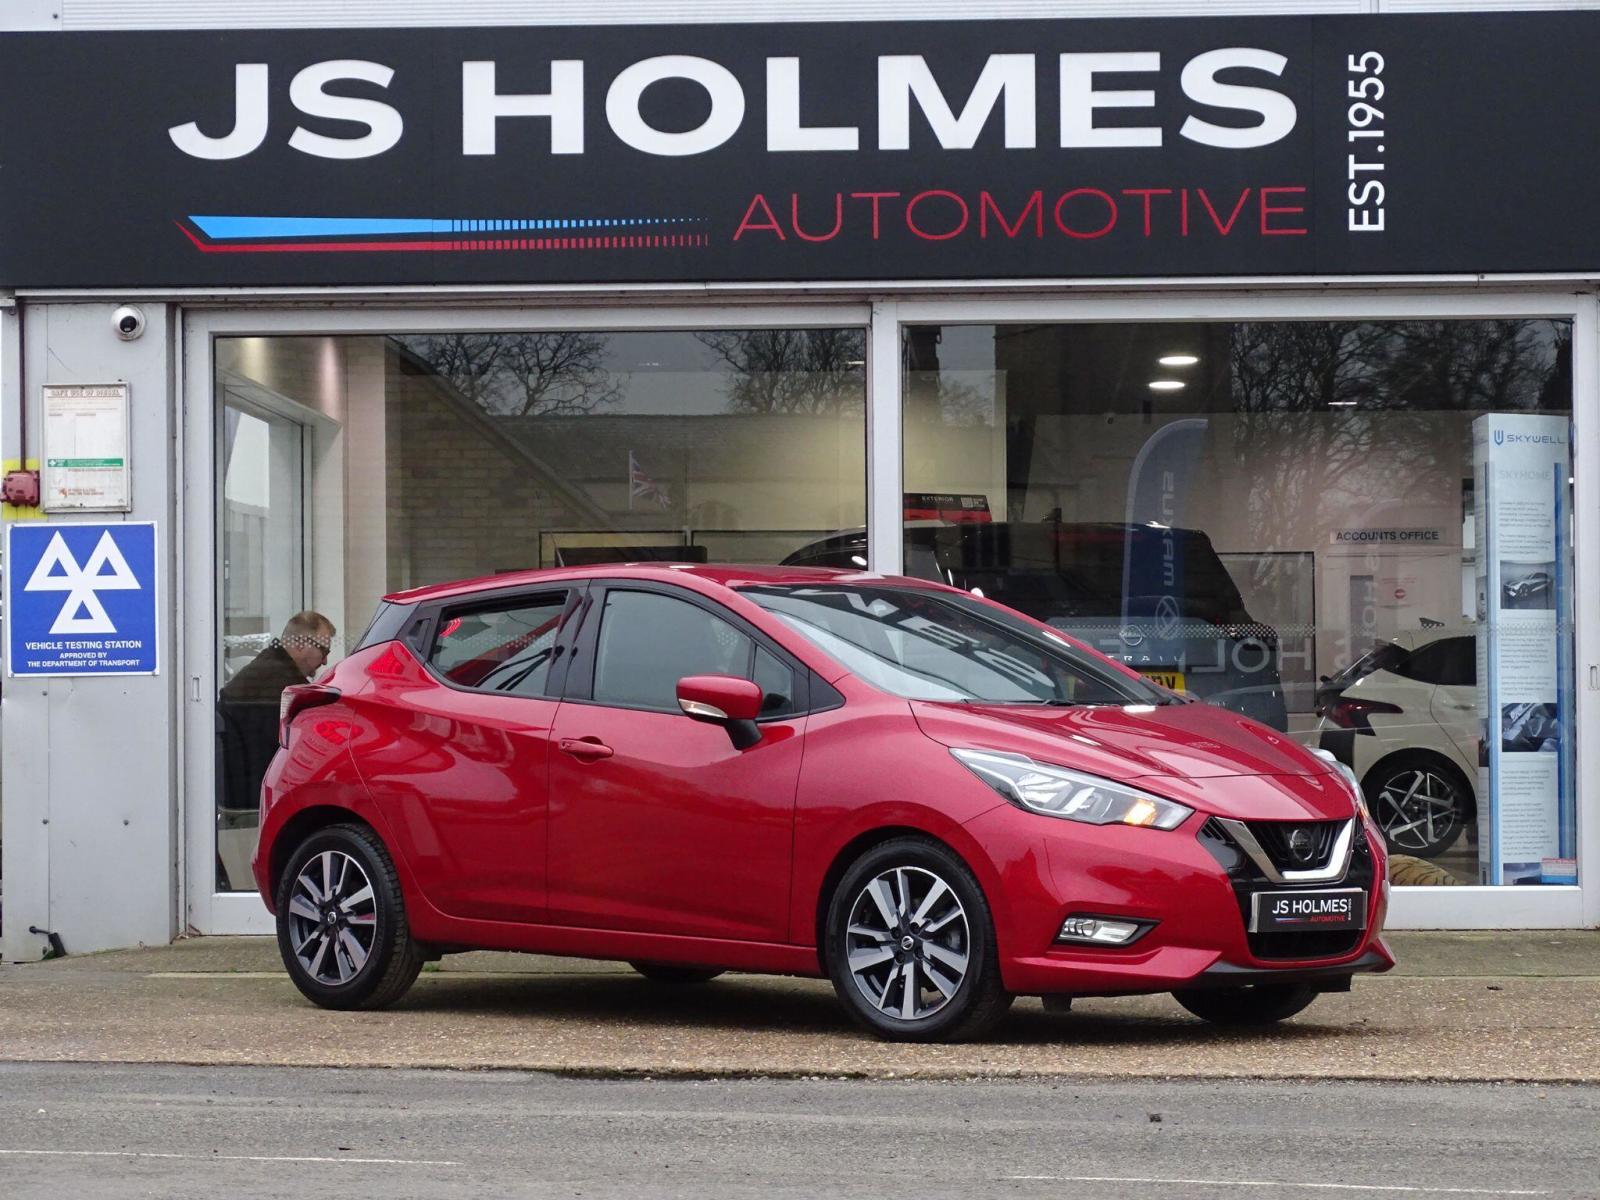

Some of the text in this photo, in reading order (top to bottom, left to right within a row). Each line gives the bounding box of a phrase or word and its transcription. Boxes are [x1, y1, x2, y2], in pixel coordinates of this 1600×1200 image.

[168, 47, 1297, 161] JS HOLMES
[1347, 51, 1385, 232] EST.1955
[733, 186, 1308, 242] AUTOMOTIVE
[1507, 434, 1566, 444] SKYWELL
[1336, 531, 1440, 541] ACCOUNTS OFFICE
[25, 640, 142, 650] VEHICLE TESTING STATION
[59, 652, 97, 660] APPROVED
[27, 660, 41, 668] THE
[99, 659, 140, 667] TRANSPORT
[1272, 898, 1348, 914] JS HOLMES
